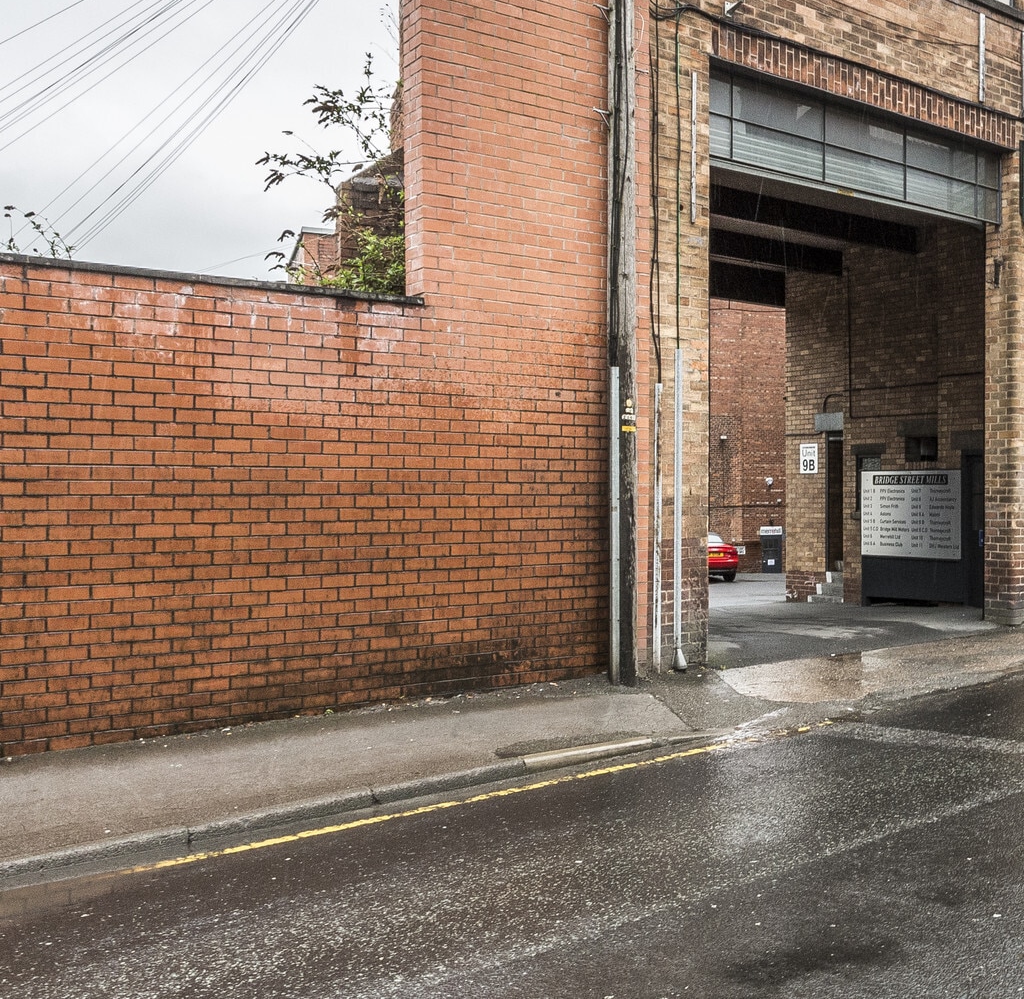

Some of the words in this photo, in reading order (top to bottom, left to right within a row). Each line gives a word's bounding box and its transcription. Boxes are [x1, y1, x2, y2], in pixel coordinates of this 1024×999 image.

[802, 449, 816, 457] Unit
[802, 459, 815, 471] 9B
[874, 476, 898, 484] BRIDGE
[900, 476, 924, 484] STREET
[926, 475, 947, 484] MILLS
